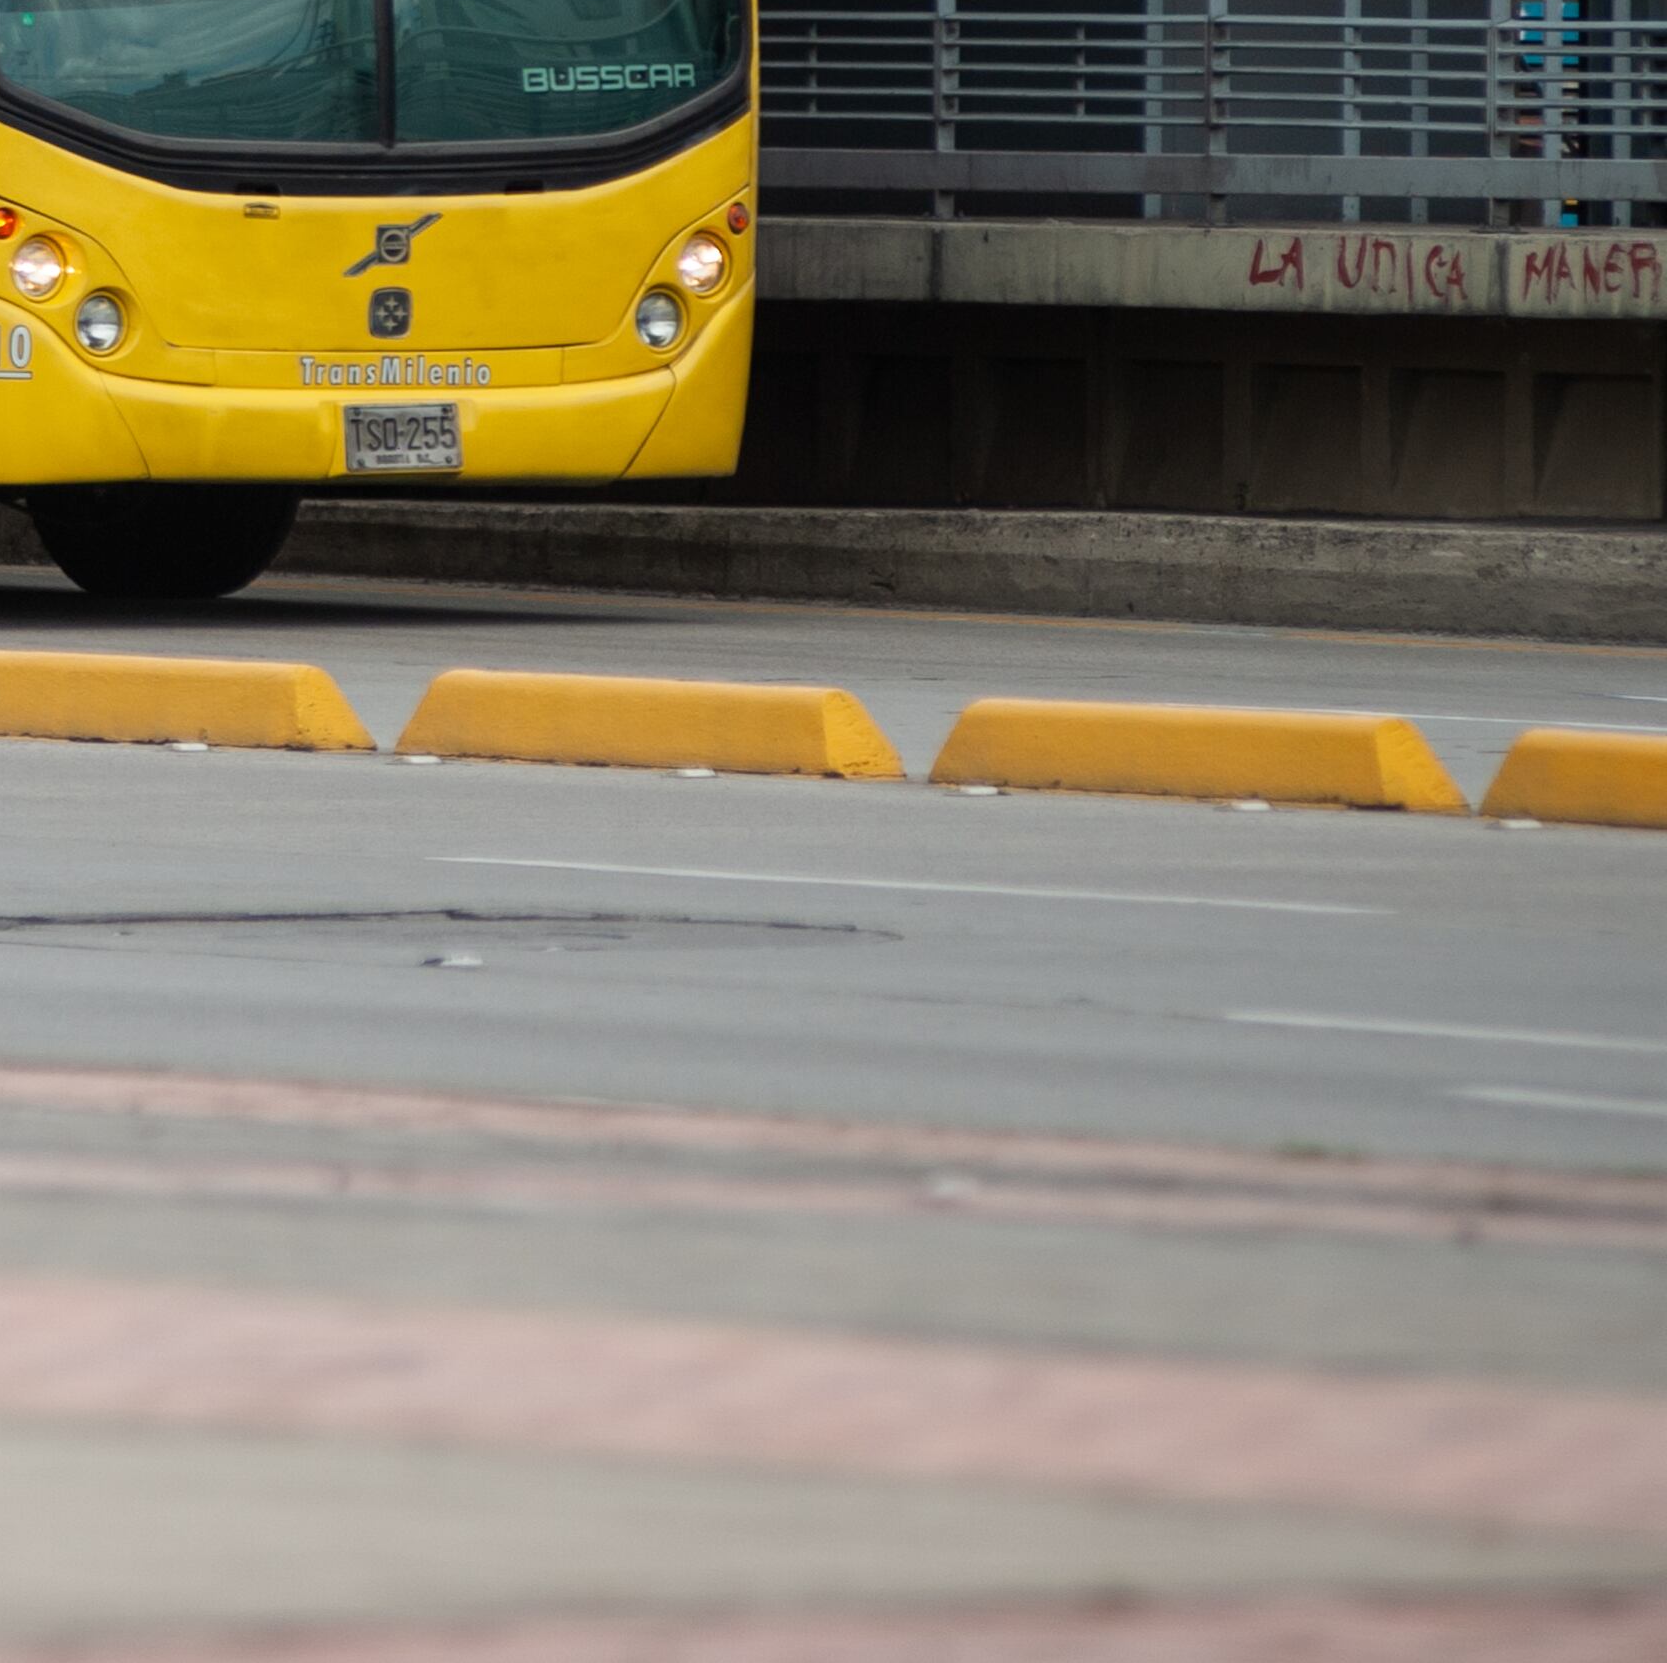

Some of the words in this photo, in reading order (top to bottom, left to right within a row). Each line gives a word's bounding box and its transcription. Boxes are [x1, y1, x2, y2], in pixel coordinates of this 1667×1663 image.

[522, 62, 696, 93] BUSSCAR
[1249, 236, 1304, 291] LA
[300, 356, 492, 386] TransMilenio
[350, 417, 457, 451] TSO-255
